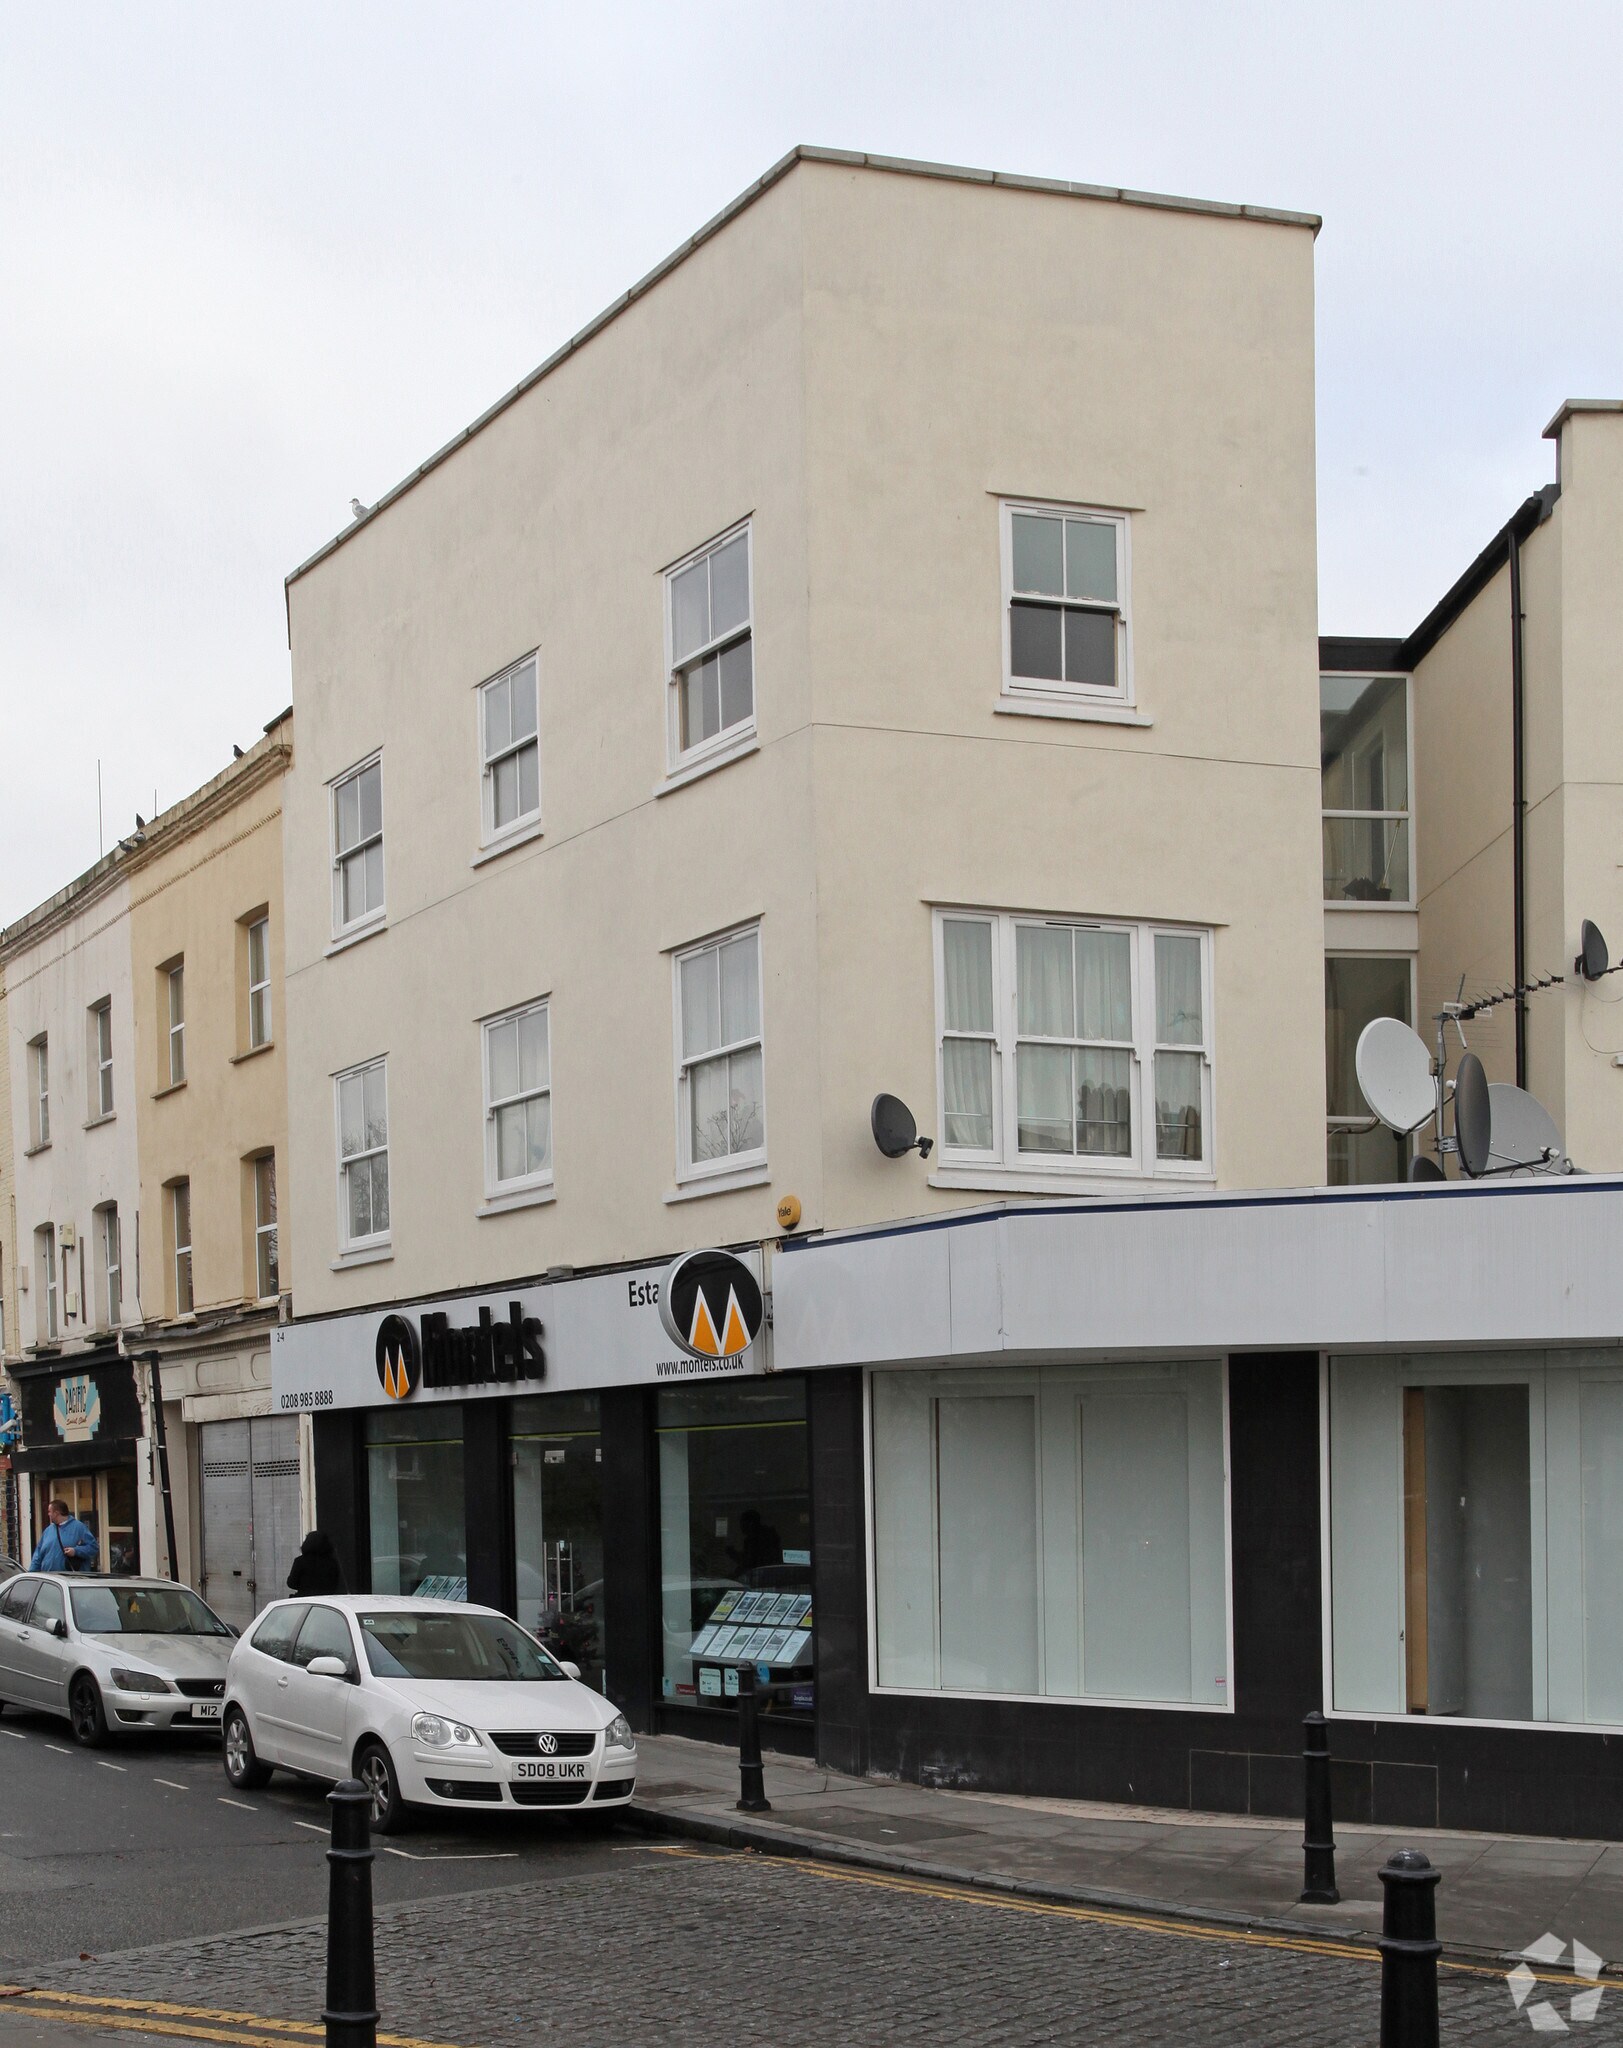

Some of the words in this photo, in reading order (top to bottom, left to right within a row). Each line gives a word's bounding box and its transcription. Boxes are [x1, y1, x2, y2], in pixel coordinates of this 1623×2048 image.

[777, 1206, 791, 1218] Yale
[65, 1385, 87, 1415] PACIFIC
[281, 1393, 299, 1409] 0208
[300, 1391, 313, 1407] 985
[314, 1389, 334, 1405] 8888
[518, 1763, 555, 1777] SD08
[559, 1763, 585, 1777] UKR
